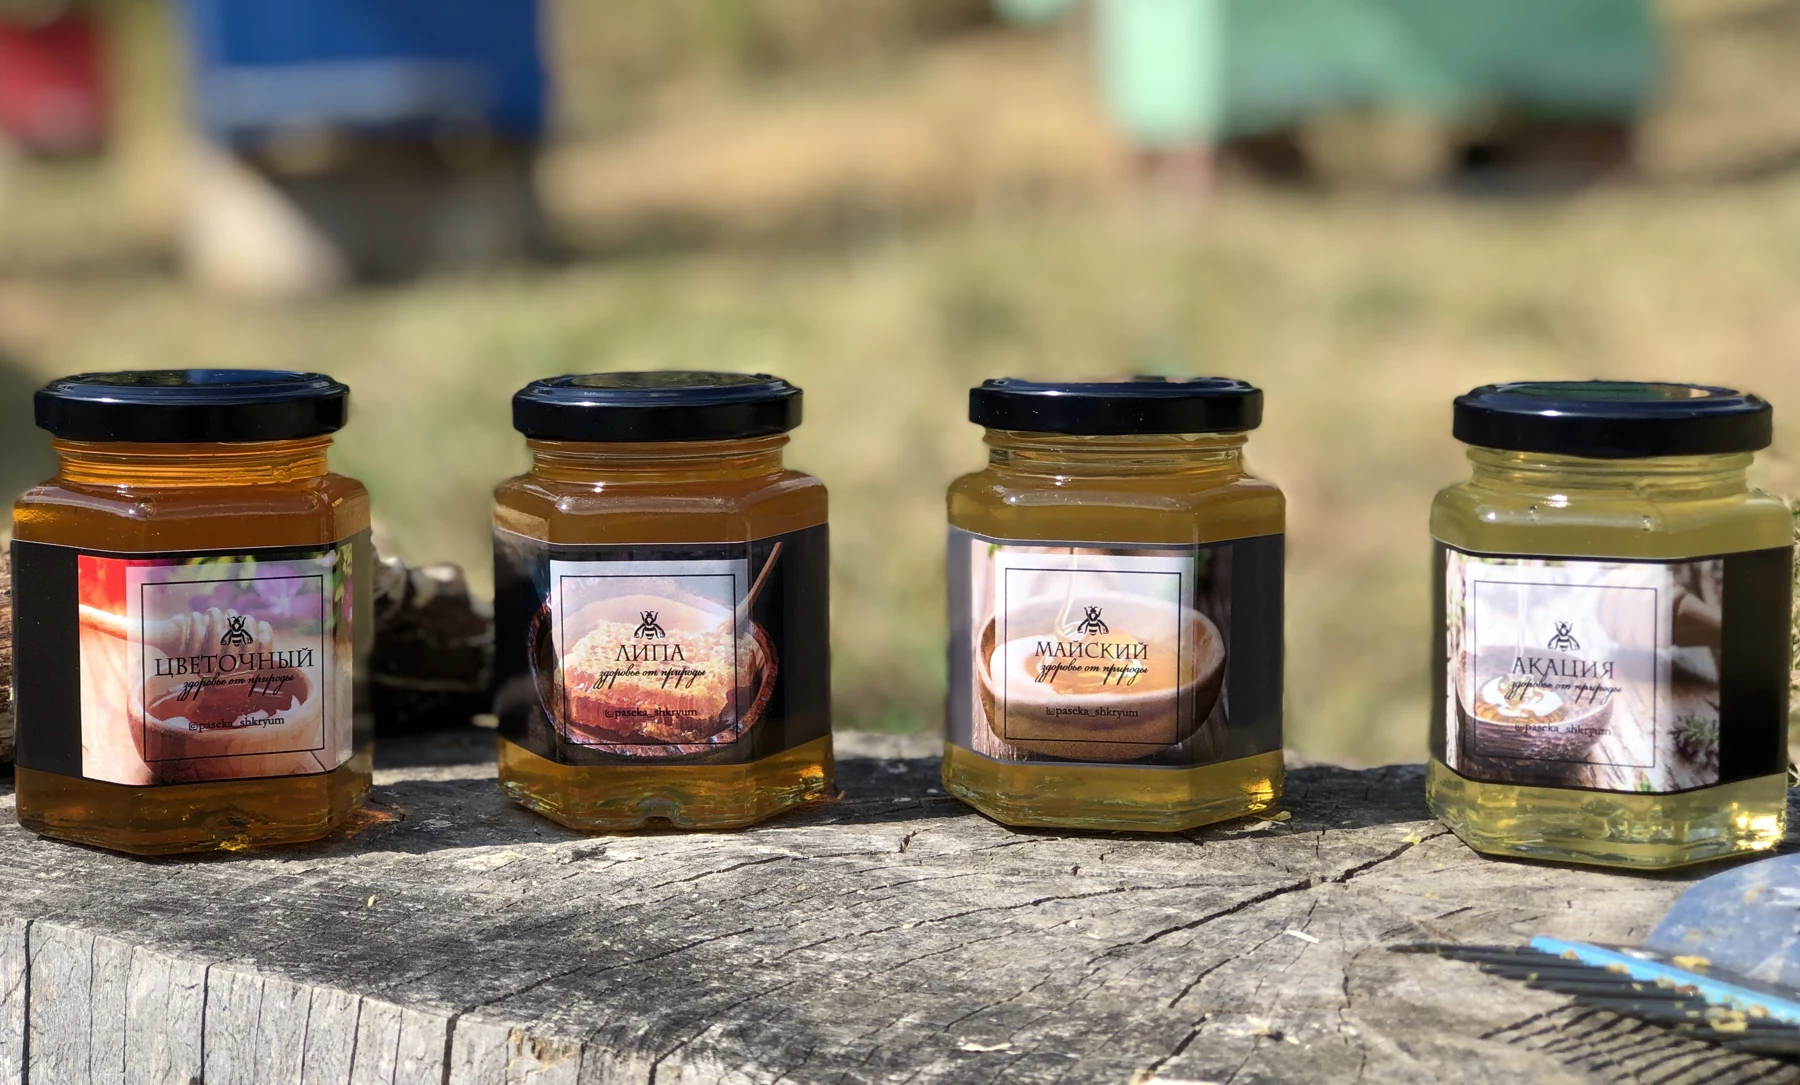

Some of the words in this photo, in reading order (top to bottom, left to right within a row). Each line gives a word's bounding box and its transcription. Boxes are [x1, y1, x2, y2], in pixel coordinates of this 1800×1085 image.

[154, 647, 314, 678] ЦВЕТОЧНЫЙ
[615, 644, 685, 662] ЛИПА
[1034, 640, 1149, 660] МАЙСКИЙ
[593, 664, 640, 690] здоровье
[661, 666, 706, 689] природы
[1035, 658, 1082, 684] здоровье
[1084, 664, 1100, 672] от
[1102, 662, 1149, 686] природы
[1512, 656, 1615, 679] АКАЦИЯ
[177, 672, 227, 701] здоровье
[228, 677, 246, 686] от
[248, 674, 295, 697] природы
